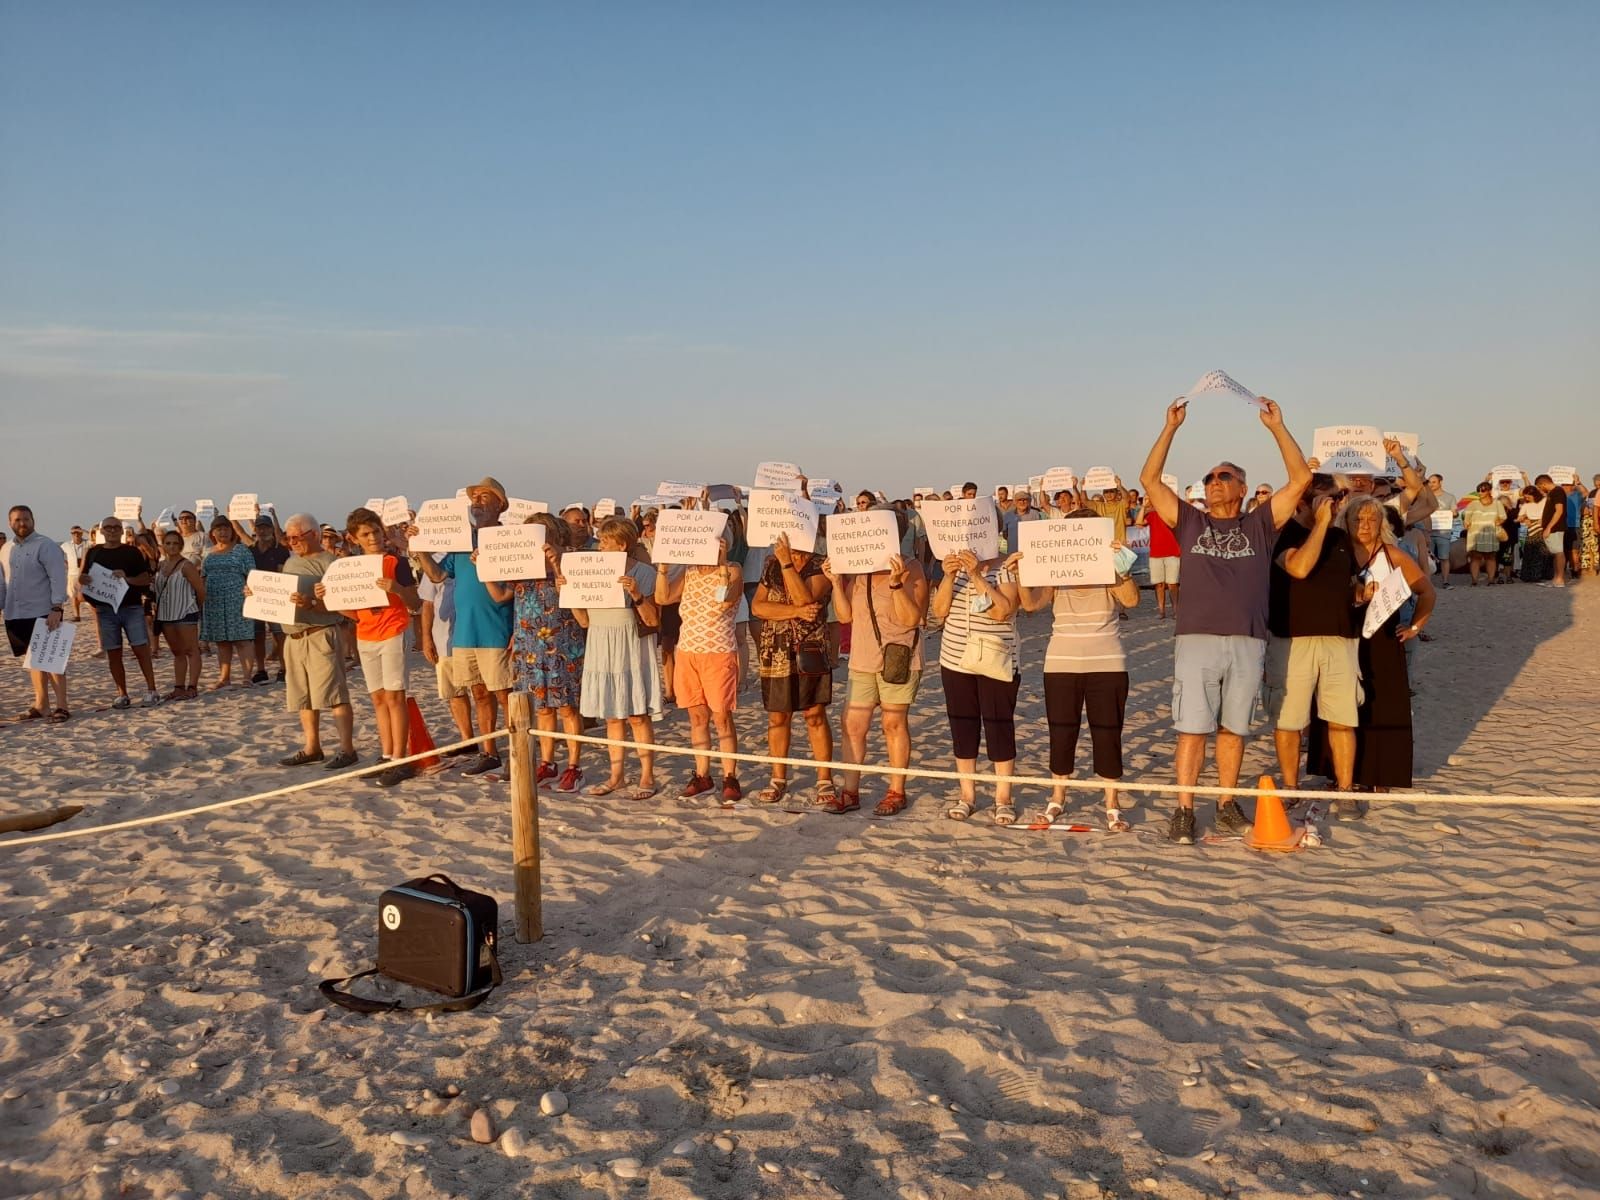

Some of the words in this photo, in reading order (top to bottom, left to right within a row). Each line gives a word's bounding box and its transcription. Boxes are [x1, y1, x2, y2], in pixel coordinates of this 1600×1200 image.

[1322, 438, 1378, 447] REGENERACIÓN
[789, 496, 798, 505] LA
[944, 505, 962, 513] POR
[418, 513, 462, 522] REGENERACIÓN
[840, 517, 856, 526] POR
[932, 516, 990, 528] REGENERACIÓN
[432, 526, 462, 534] NUESTRAS
[660, 525, 714, 533] REGENERACIÓN
[770, 521, 804, 530] NUESTRAS
[1048, 524, 1067, 533] POR
[1072, 523, 1083, 531] LA
[831, 528, 888, 540] REGENERACIÓN
[938, 533, 946, 541] DE
[947, 531, 987, 542] NUESTRAS
[484, 540, 536, 550] REGENERACIÓN
[1030, 536, 1102, 549] REGENERACIÓN
[846, 542, 886, 553] NUESTRAS
[499, 554, 534, 562] NUESTRAS
[848, 558, 873, 566] PLAYAS
[1036, 556, 1048, 564] DE
[1050, 552, 1098, 563] NUESTRAS
[328, 571, 375, 581] REGENERACIÓN
[568, 568, 616, 576] REGENERACIÓN
[1050, 569, 1084, 578] PLAYAS
[341, 584, 374, 592] NUESTRAS
[263, 597, 286, 607] NUESTRAS
[59, 640, 68, 657] PLAYAS
